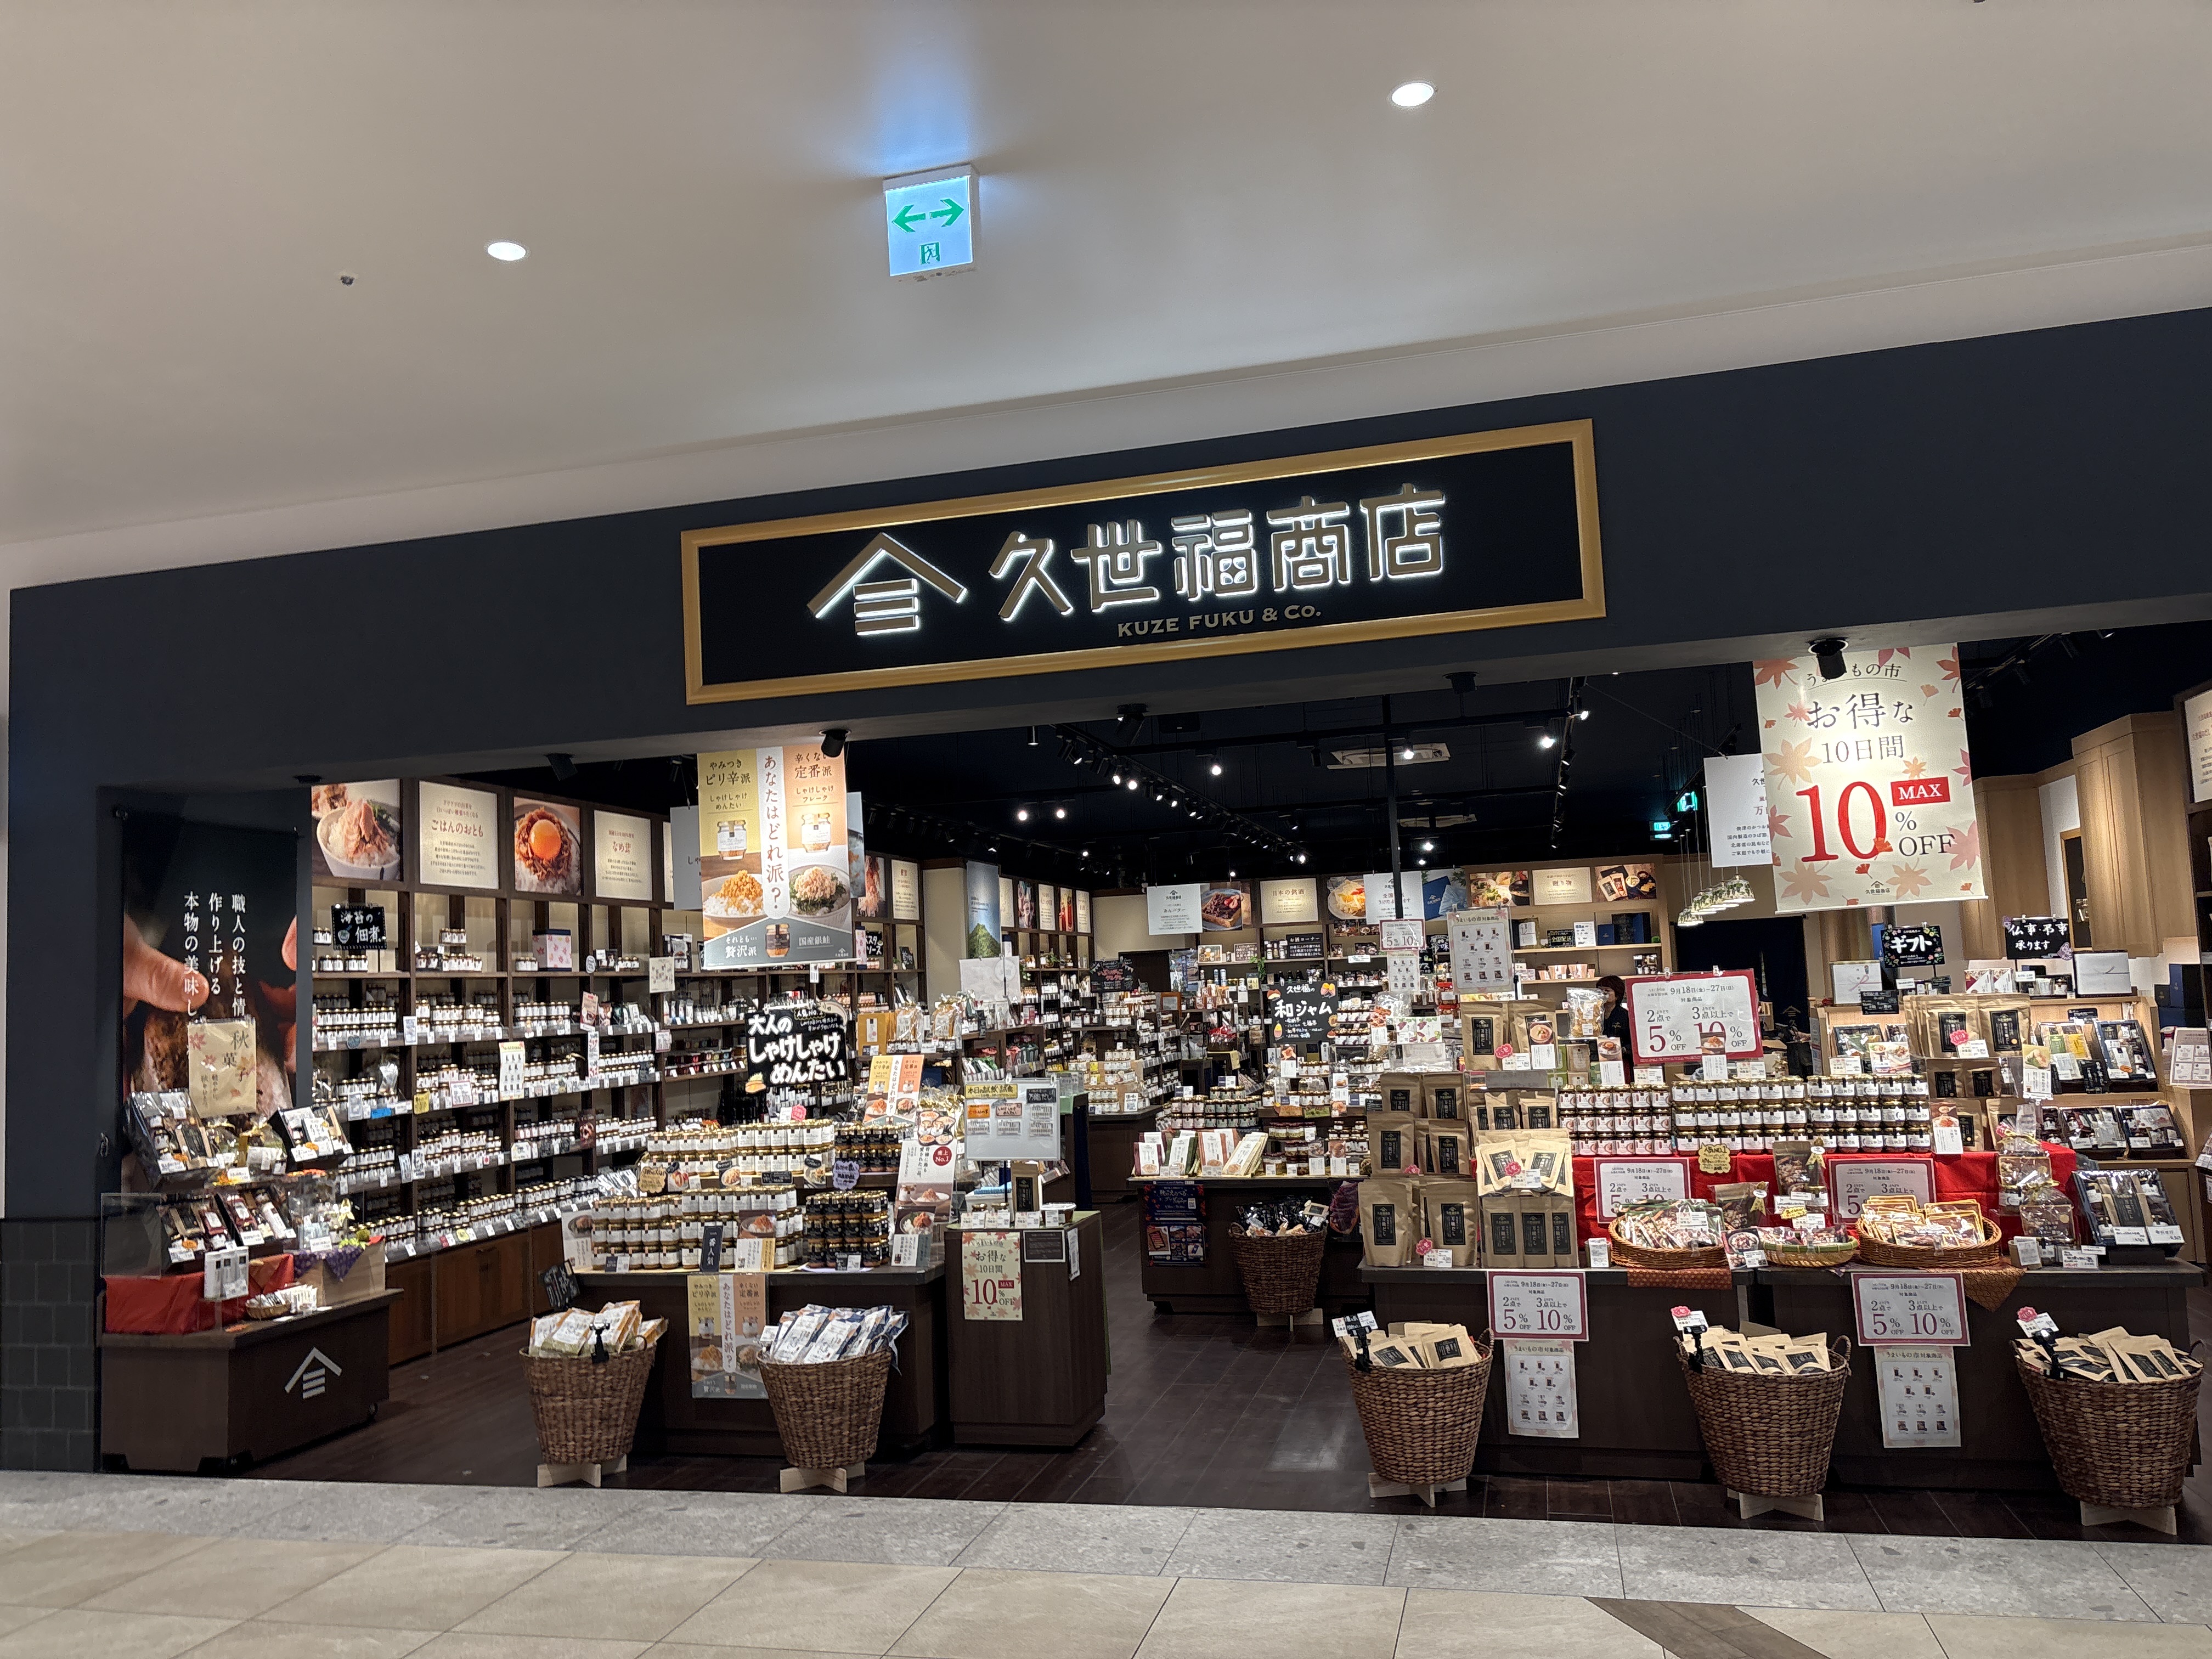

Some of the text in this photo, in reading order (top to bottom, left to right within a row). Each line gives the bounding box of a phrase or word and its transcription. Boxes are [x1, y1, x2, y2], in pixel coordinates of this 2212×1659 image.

[989, 482, 1446, 621] 久世福商店
[1118, 618, 1178, 637] KUZE
[1189, 610, 1254, 630] FUKU
[1262, 608, 1278, 622] &
[1807, 663, 1901, 686] うもの市
[1807, 693, 1914, 729] お得な
[1821, 735, 1904, 764] 10日間
[710, 759, 742, 770] やみつき
[795, 764, 832, 778] 定番派
[706, 771, 751, 786] ピリ辛派
[710, 792, 747, 802] しゃけしゃけ
[797, 785, 833, 794] しゃけしゃけ
[1899, 783, 1943, 800] MAX
[432, 820, 483, 837] ごはんのおとも
[1796, 781, 1887, 862] 10
[1895, 811, 1917, 831] %
[1899, 833, 1955, 856] OFF
[340, 911, 374, 925] 海苔の
[208, 893, 223, 995] 作り上げる
[356, 926, 382, 944] 佃煮
[1387, 937, 1392, 946] 5
[1890, 934, 1932, 953] ギフト
[2015, 940, 2050, 950] 承ります
[725, 945, 757, 958] 贅沢派
[1286, 984, 1315, 994] 久世福の
[1274, 1000, 1332, 1018] 和ジャム
[748, 1015, 793, 1036] 大人の
[1730, 1026, 1742, 1038] %
[749, 1031, 842, 1063] しゃけしゃけ
[1650, 1025, 1681, 1052] 5 %
[770, 1058, 846, 1084] めんたい
[1848, 1195, 1860, 1215] 5
[975, 1250, 1006, 1262] お得な
[980, 1265, 1003, 1273] 10日間
[971, 1279, 998, 1305] 10
[1503, 1309, 1528, 1330] 5 %
[1537, 1309, 1573, 1330] 10 %
[1873, 1313, 1900, 1335] 5 %
[1910, 1312, 1951, 1335] 10 %
